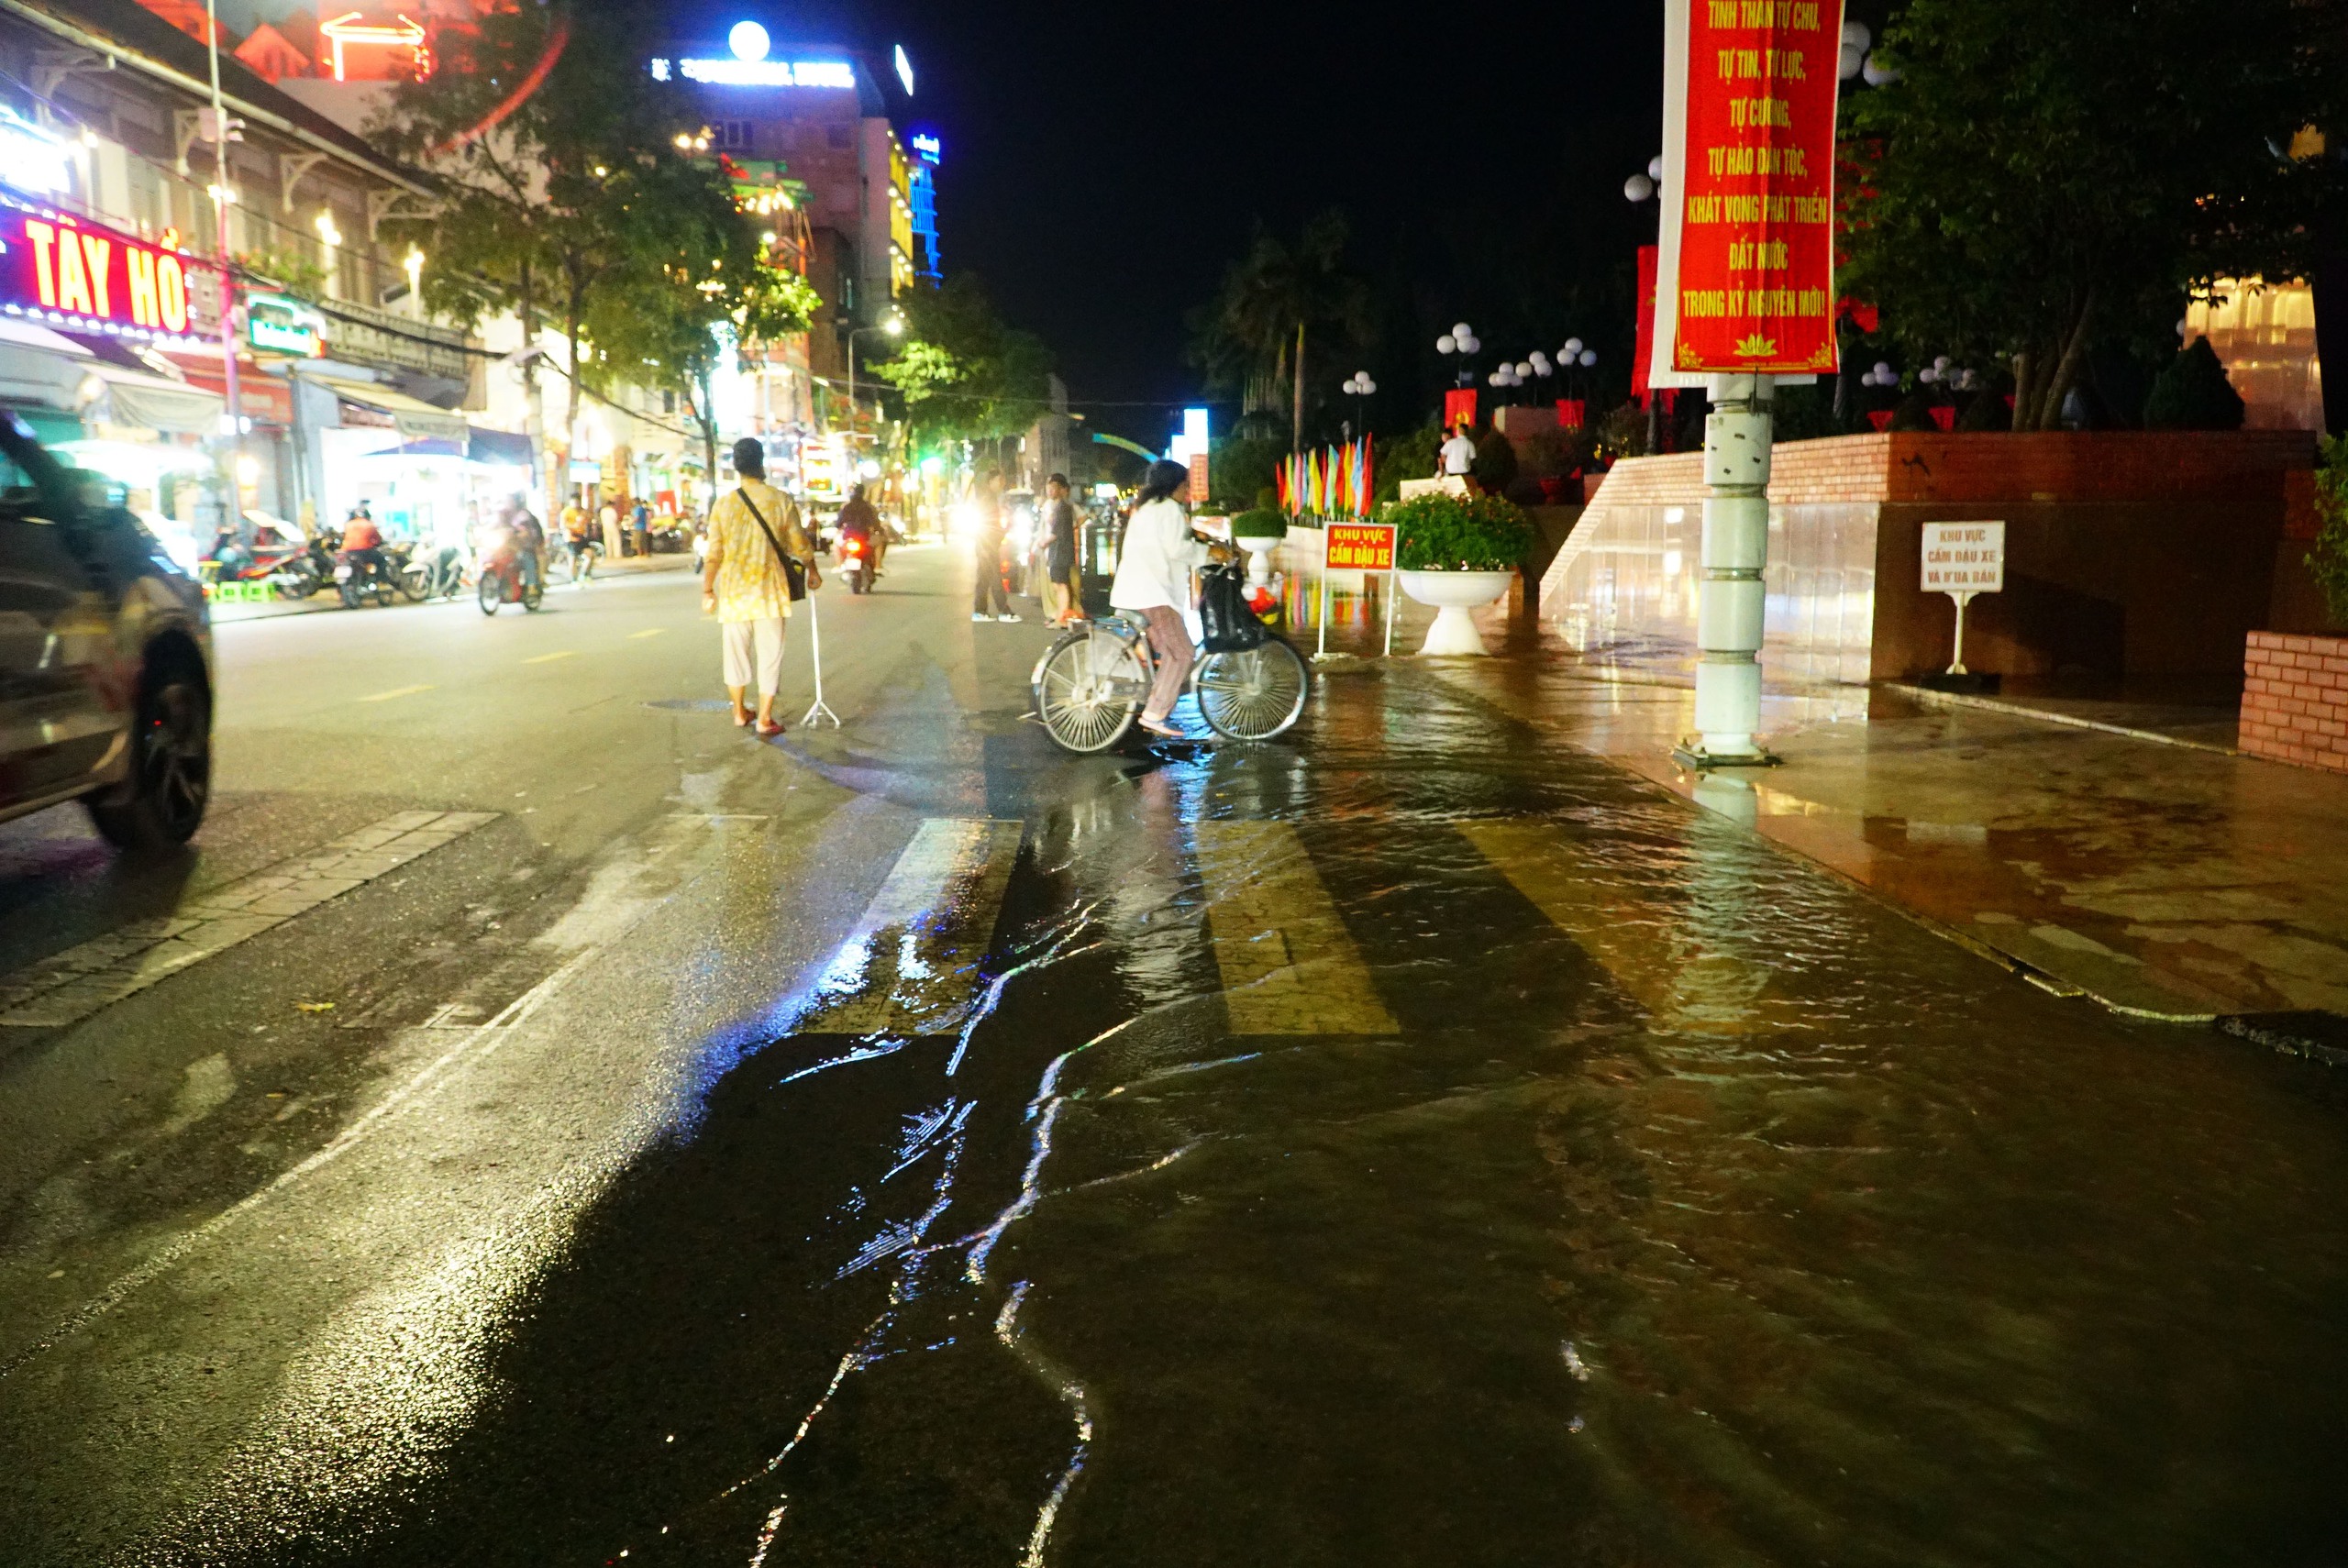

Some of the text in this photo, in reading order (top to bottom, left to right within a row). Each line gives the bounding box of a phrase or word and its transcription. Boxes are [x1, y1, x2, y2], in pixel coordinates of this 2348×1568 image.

[1709, 0, 1737, 28] TINH
[1718, 48, 1807, 85] TỰ TIN, TỰ LỰC,
[1730, 93, 1792, 134] TỰ CƯỜNG,
[1708, 141, 1808, 182] TỰ HÀO DÂN TỘC,
[1689, 187, 1828, 230] KHÁT VỌNG PHÁT TRIỂN
[26, 214, 110, 317] TÂY
[1730, 233, 1789, 271] ĐẤT NƯỚC
[1683, 280, 1826, 318] TRONG KỶ NGUYÊN MỚI!
[1334, 528, 1387, 544] KHU VỰC
[1928, 546, 1952, 562] CẤM
[1981, 550, 1997, 563] XE
[1939, 528, 1986, 546] KHU VỰC
[1329, 542, 1390, 568] CẤM ĐẬU XE
[1928, 569, 1941, 583] VÀ
[1972, 569, 1997, 583] BÁN
